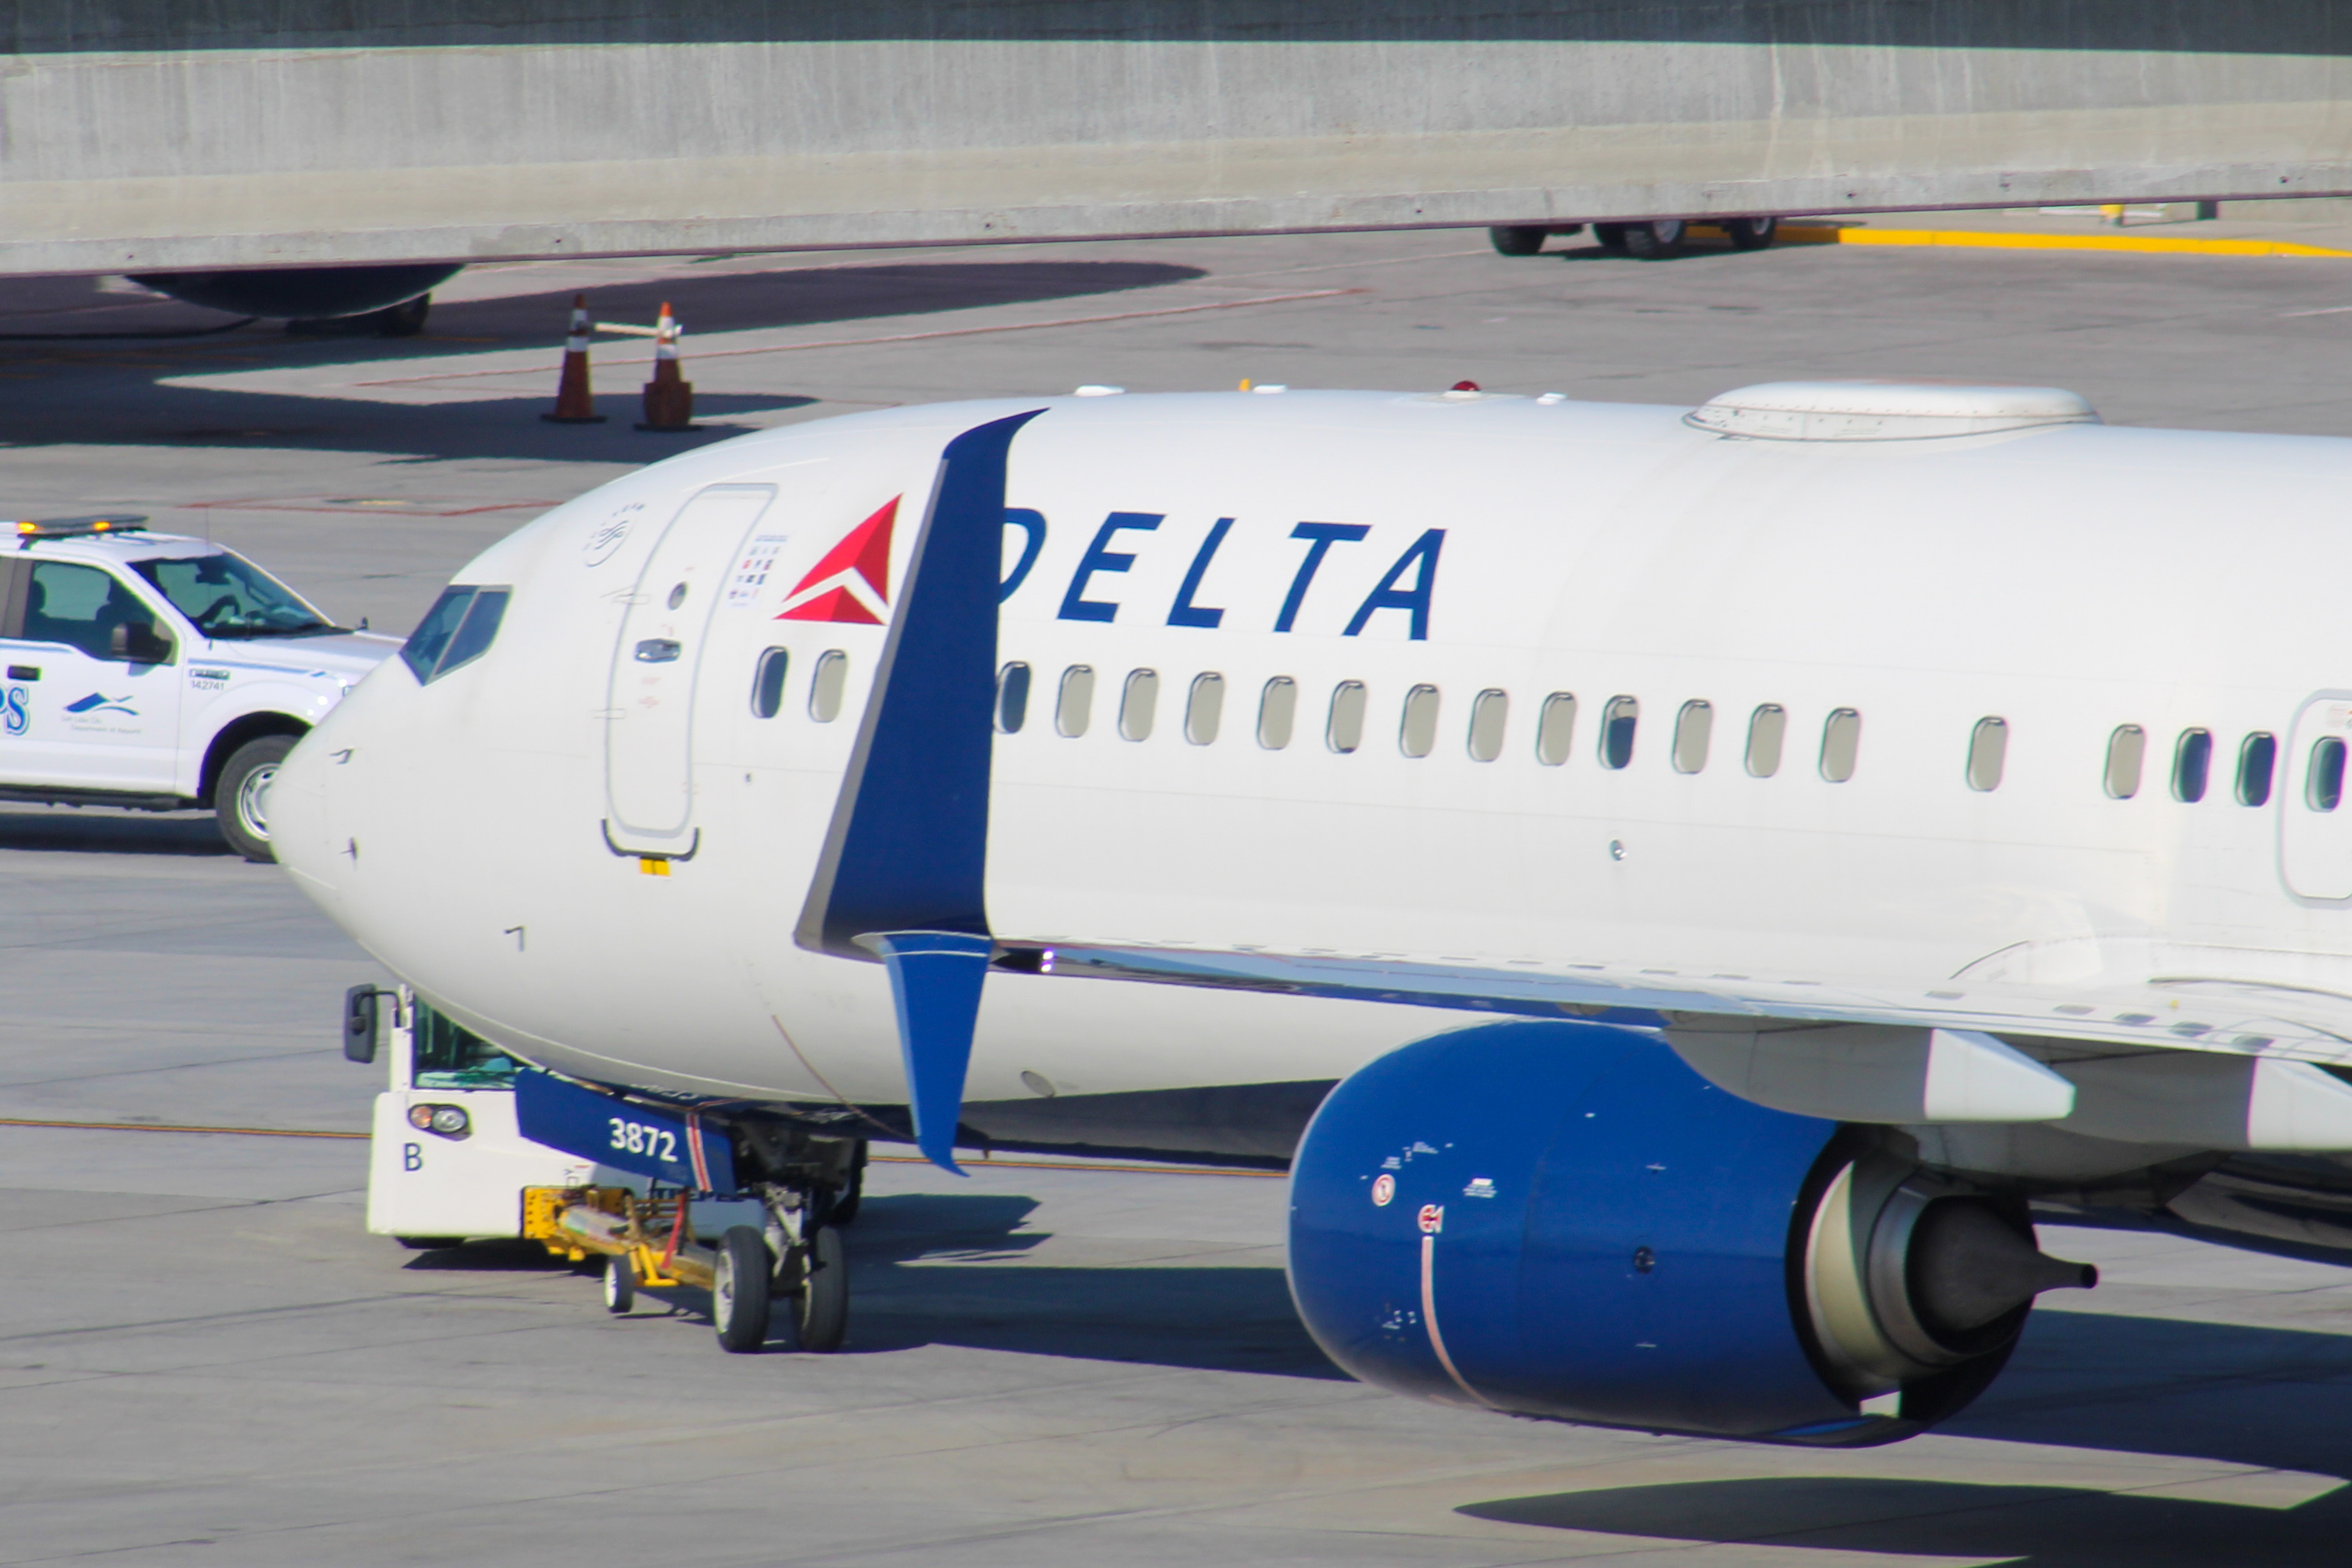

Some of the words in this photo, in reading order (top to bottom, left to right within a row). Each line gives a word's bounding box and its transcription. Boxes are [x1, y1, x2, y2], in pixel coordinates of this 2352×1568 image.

[999, 508, 1448, 641] DELTA
[405, 1142, 422, 1171] B
[608, 1117, 678, 1162] 3872
